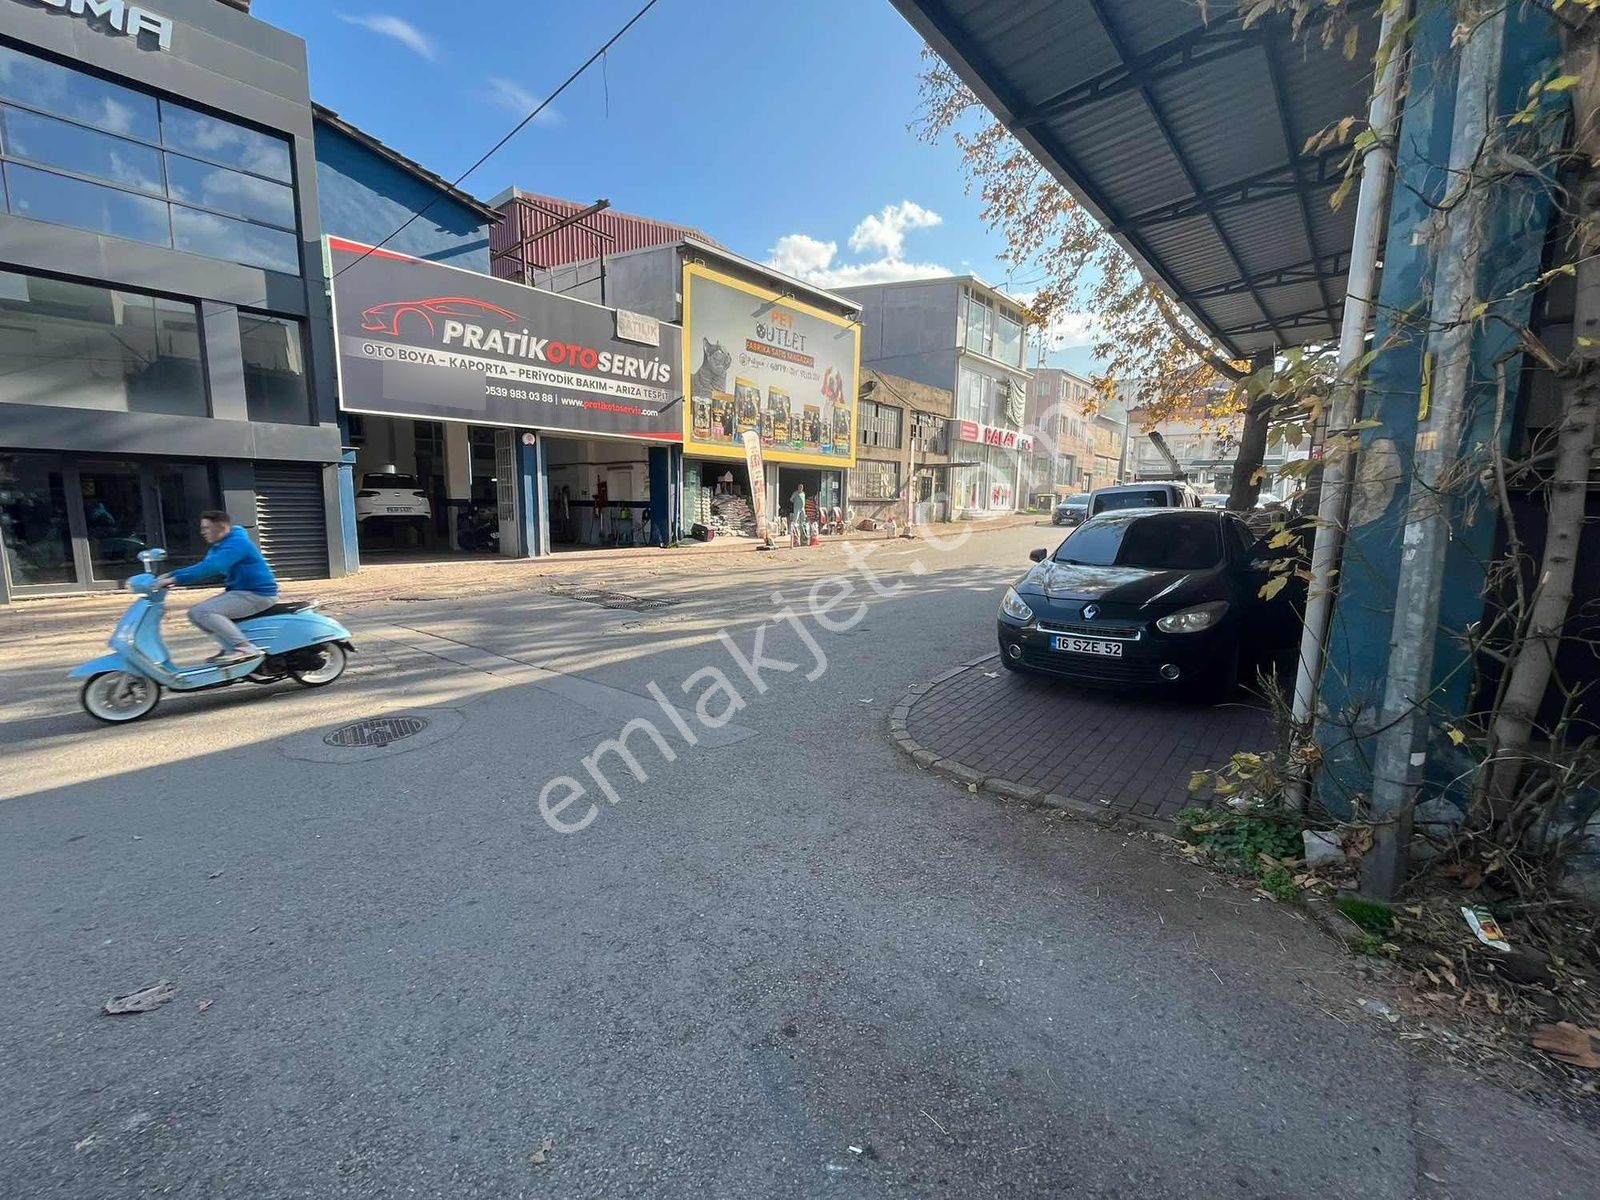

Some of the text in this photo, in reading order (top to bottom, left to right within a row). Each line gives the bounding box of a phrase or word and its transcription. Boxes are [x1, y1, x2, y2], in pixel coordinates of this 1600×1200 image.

[41, 0, 173, 50] MA
[363, 343, 395, 358] OTO
[398, 348, 436, 365] BOYA
[449, 357, 507, 376] KAPORTA
[576, 379, 607, 391] BAKIM
[615, 384, 642, 397] ARIZA
[509, 389, 526, 399] 983
[528, 391, 540, 401] 03
[541, 393, 554, 403] 88
[1057, 638, 1121, 655] 16 SZE 52
